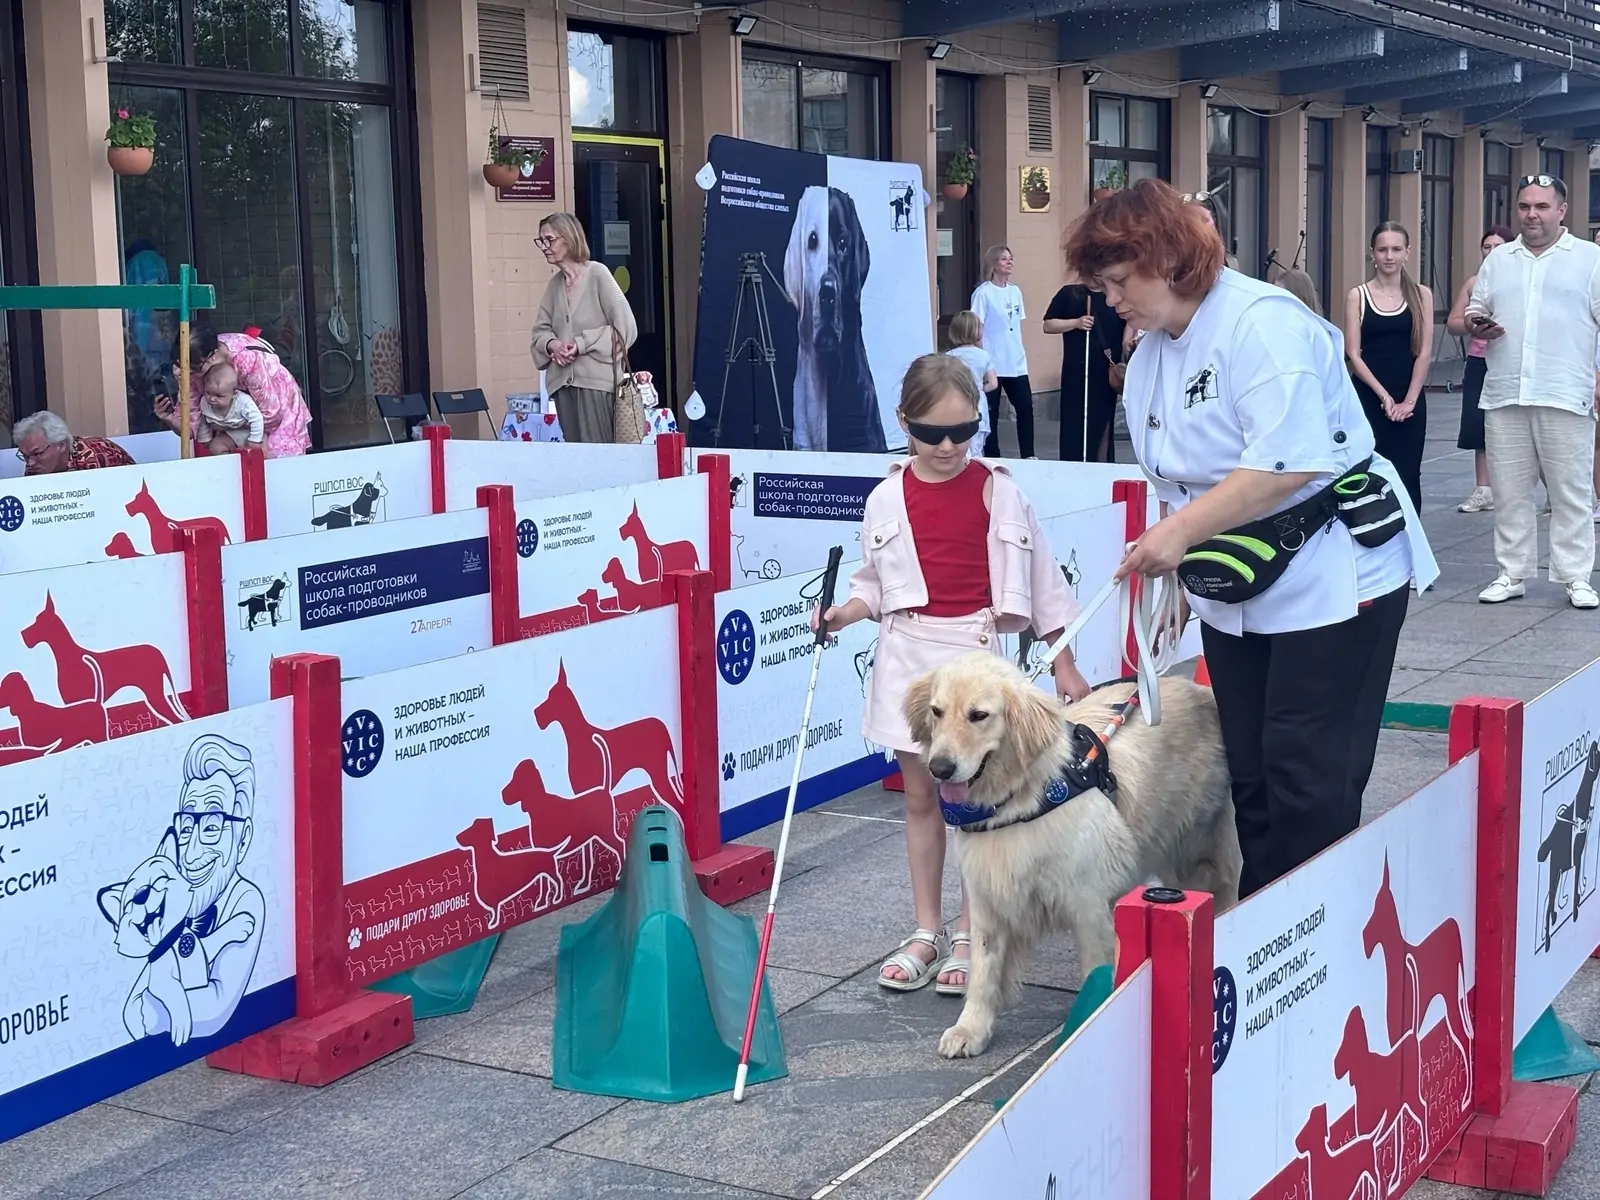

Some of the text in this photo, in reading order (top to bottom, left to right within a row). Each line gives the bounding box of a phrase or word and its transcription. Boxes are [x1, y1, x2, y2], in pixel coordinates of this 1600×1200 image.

[314, 476, 364, 493] РШПСП ВОС
[758, 476, 824, 490] Российская
[30, 488, 91, 503] ЗДОРОВЬЕ ЛЮДЕЙ
[759, 491, 863, 505] школа подготовки
[31, 506, 37, 514] И
[38, 502, 78, 514] ЖИВОТНЫХ
[32, 510, 95, 526] НАША ПРОФЕССИЯ
[543, 509, 593, 527] ЗДОРОВЬЕ ЛЮДЕЙ
[759, 501, 865, 516] собак-проводнико
[543, 531, 549, 539] И
[549, 525, 582, 538] ЖИВОТНЫХ
[543, 535, 596, 551] НАША ПРОФЕССИЯ
[304, 563, 377, 586] Российская
[304, 573, 418, 604] школа подготовки
[305, 587, 428, 621] собак-проводников
[760, 602, 803, 624] ЗДОРОВЬЕ
[760, 622, 812, 646] И ЖИВОТНЫ
[761, 651, 787, 669] НАША
[394, 684, 486, 719] ЗДОРОВЬЕ ЛЮДЕЙ
[394, 727, 403, 741] И
[405, 711, 467, 737] ЖИВОТНЫХ
[395, 725, 490, 762] НАША ПРОФЕССИЯ
[1574, 730, 1591, 763] ВОС
[740, 743, 774, 772] ПОДАРИ
[366, 892, 471, 942] ПОДАРИ ДРУГУ ЗДОРОВЬЕ
[1246, 903, 1325, 975] ЗДОРОВЬЕ ЛЮДЕЙ
[1246, 988, 1254, 1007] И
[1256, 947, 1309, 1001] ЖИВОТНЫХ
[1245, 964, 1328, 1040] НАША ПРОФЕССИЯ
[0, 993, 70, 1045] ОРОВЬЕ
[1212, 1002, 1233, 1033] IC
